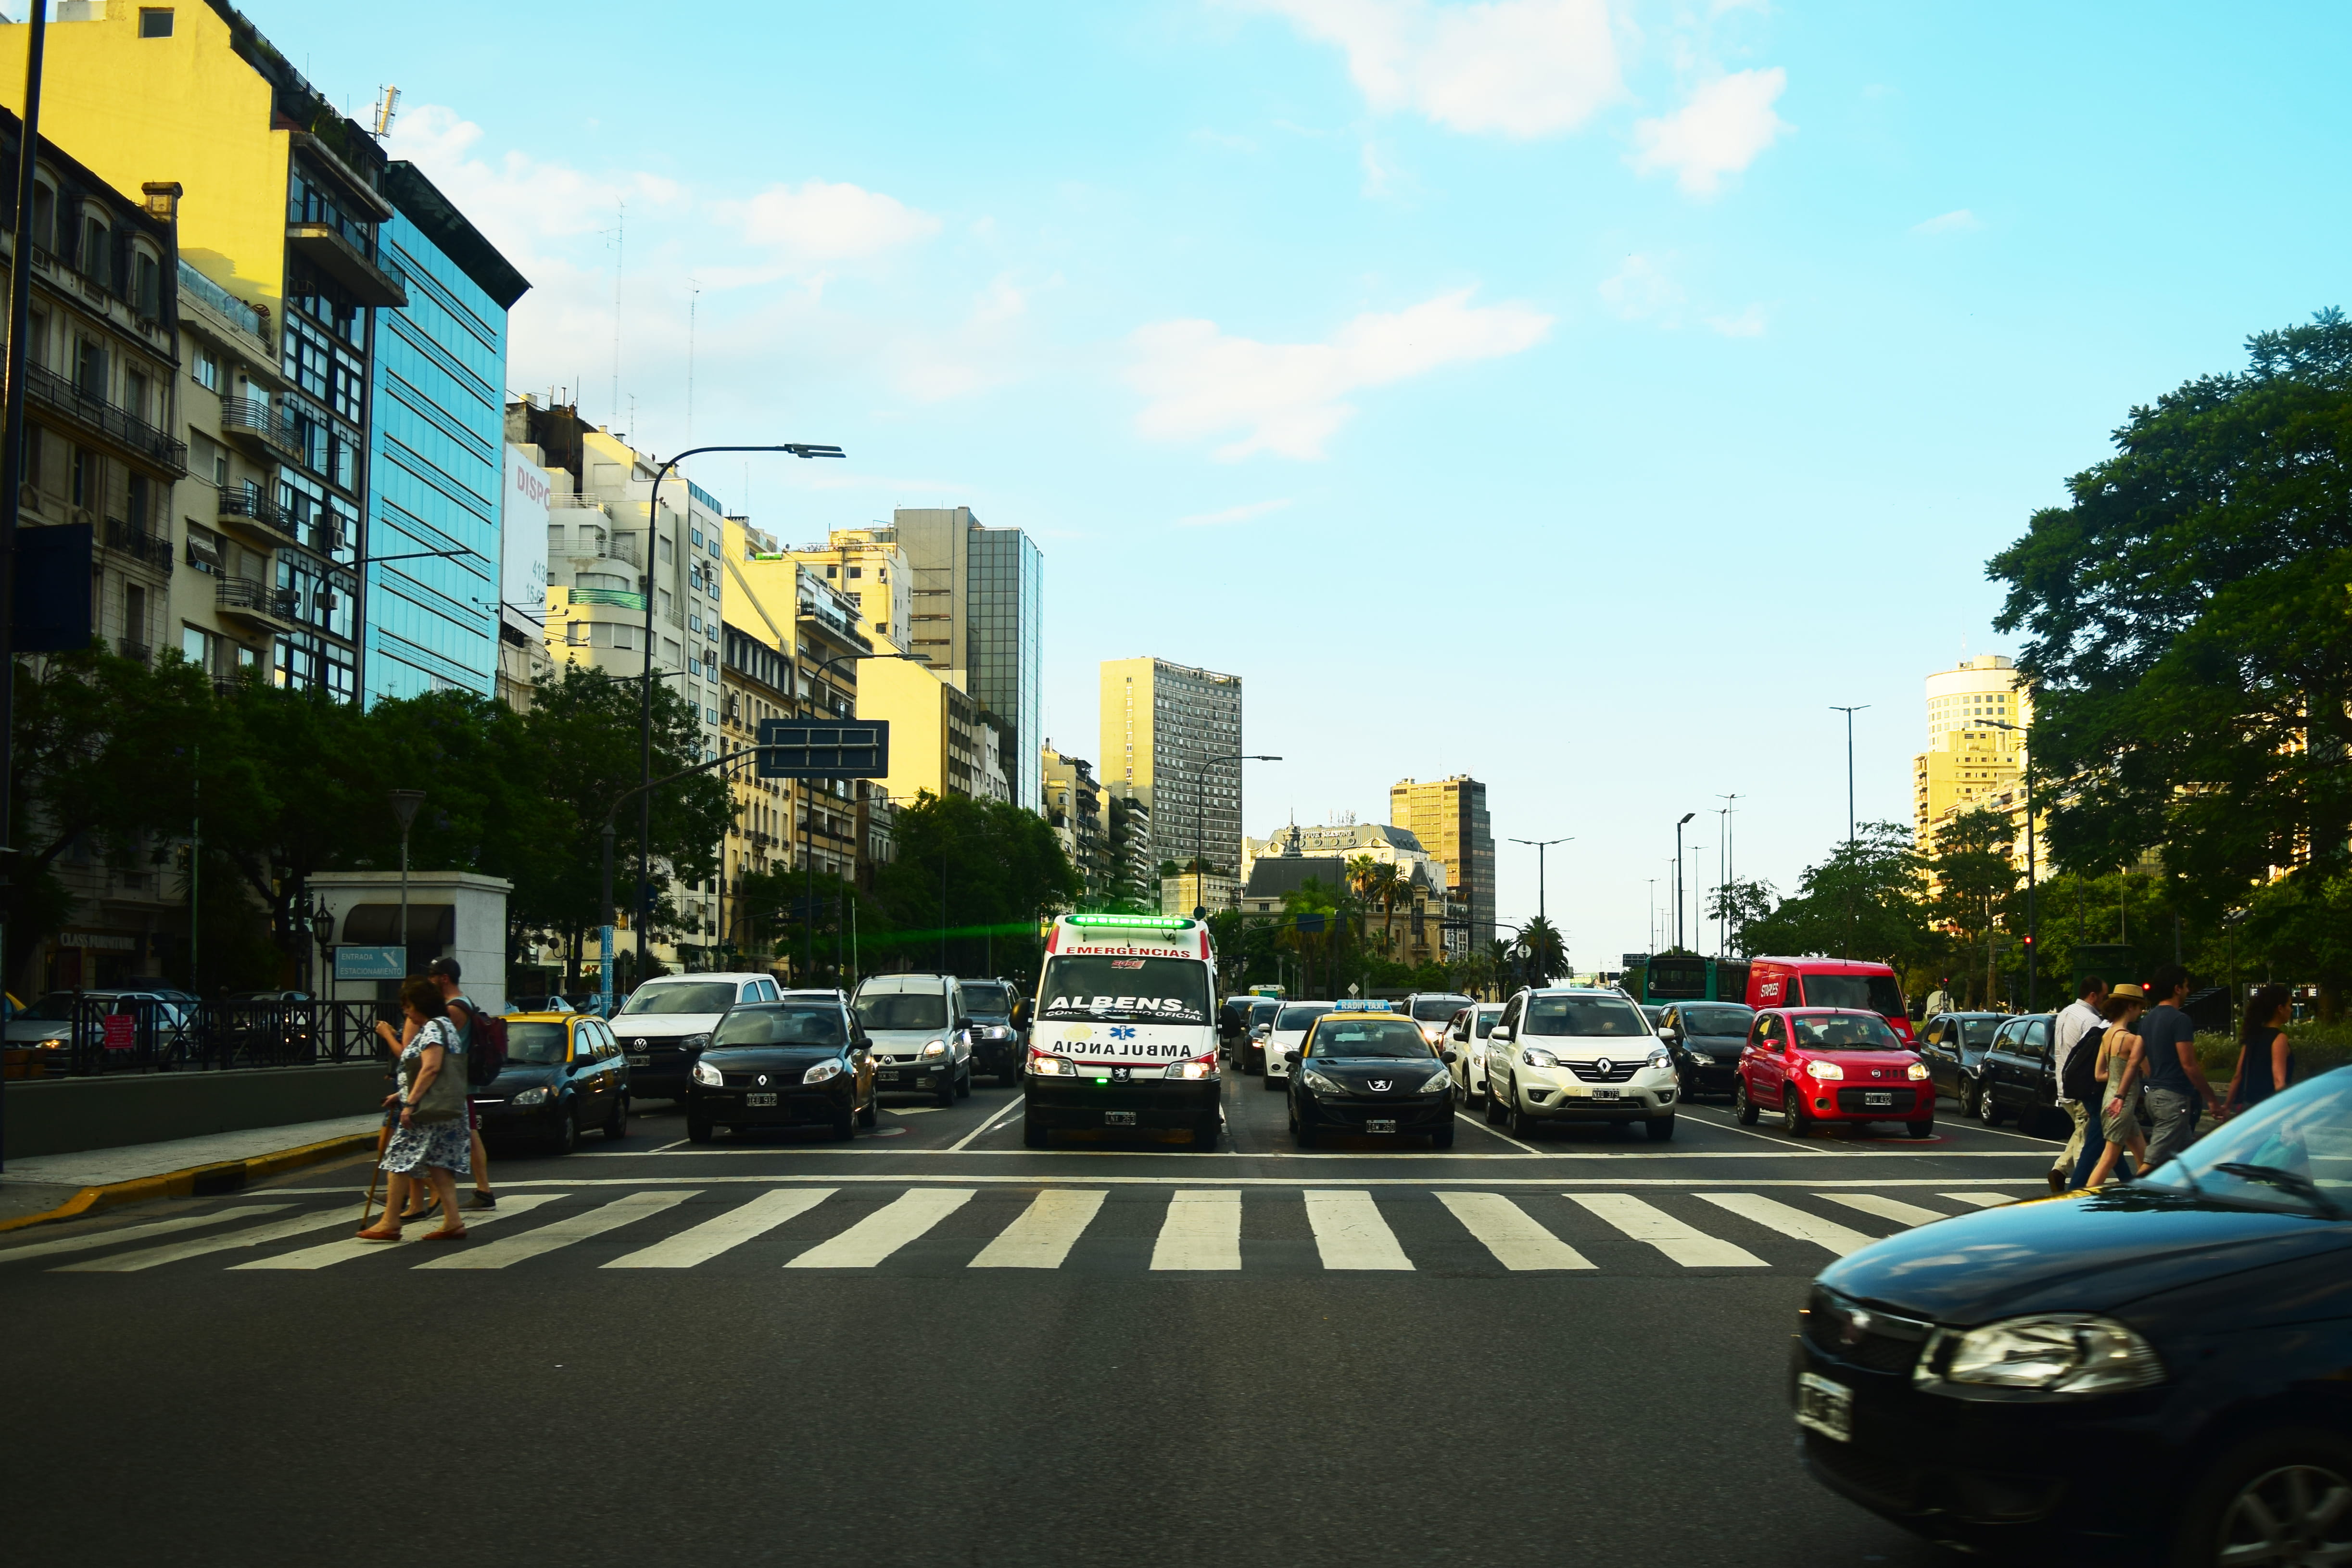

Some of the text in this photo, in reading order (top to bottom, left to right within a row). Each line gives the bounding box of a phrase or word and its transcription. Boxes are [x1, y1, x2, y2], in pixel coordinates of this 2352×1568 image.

[61, 933, 88, 947] CLASS
[1066, 947, 1190, 958] EMERGENCIAS
[1760, 982, 1779, 998] STAPLES
[1047, 996, 1183, 1012] ALBENS
[1341, 1001, 1365, 1010] RADIO
[1155, 1012, 1202, 1022] OFICIAL
